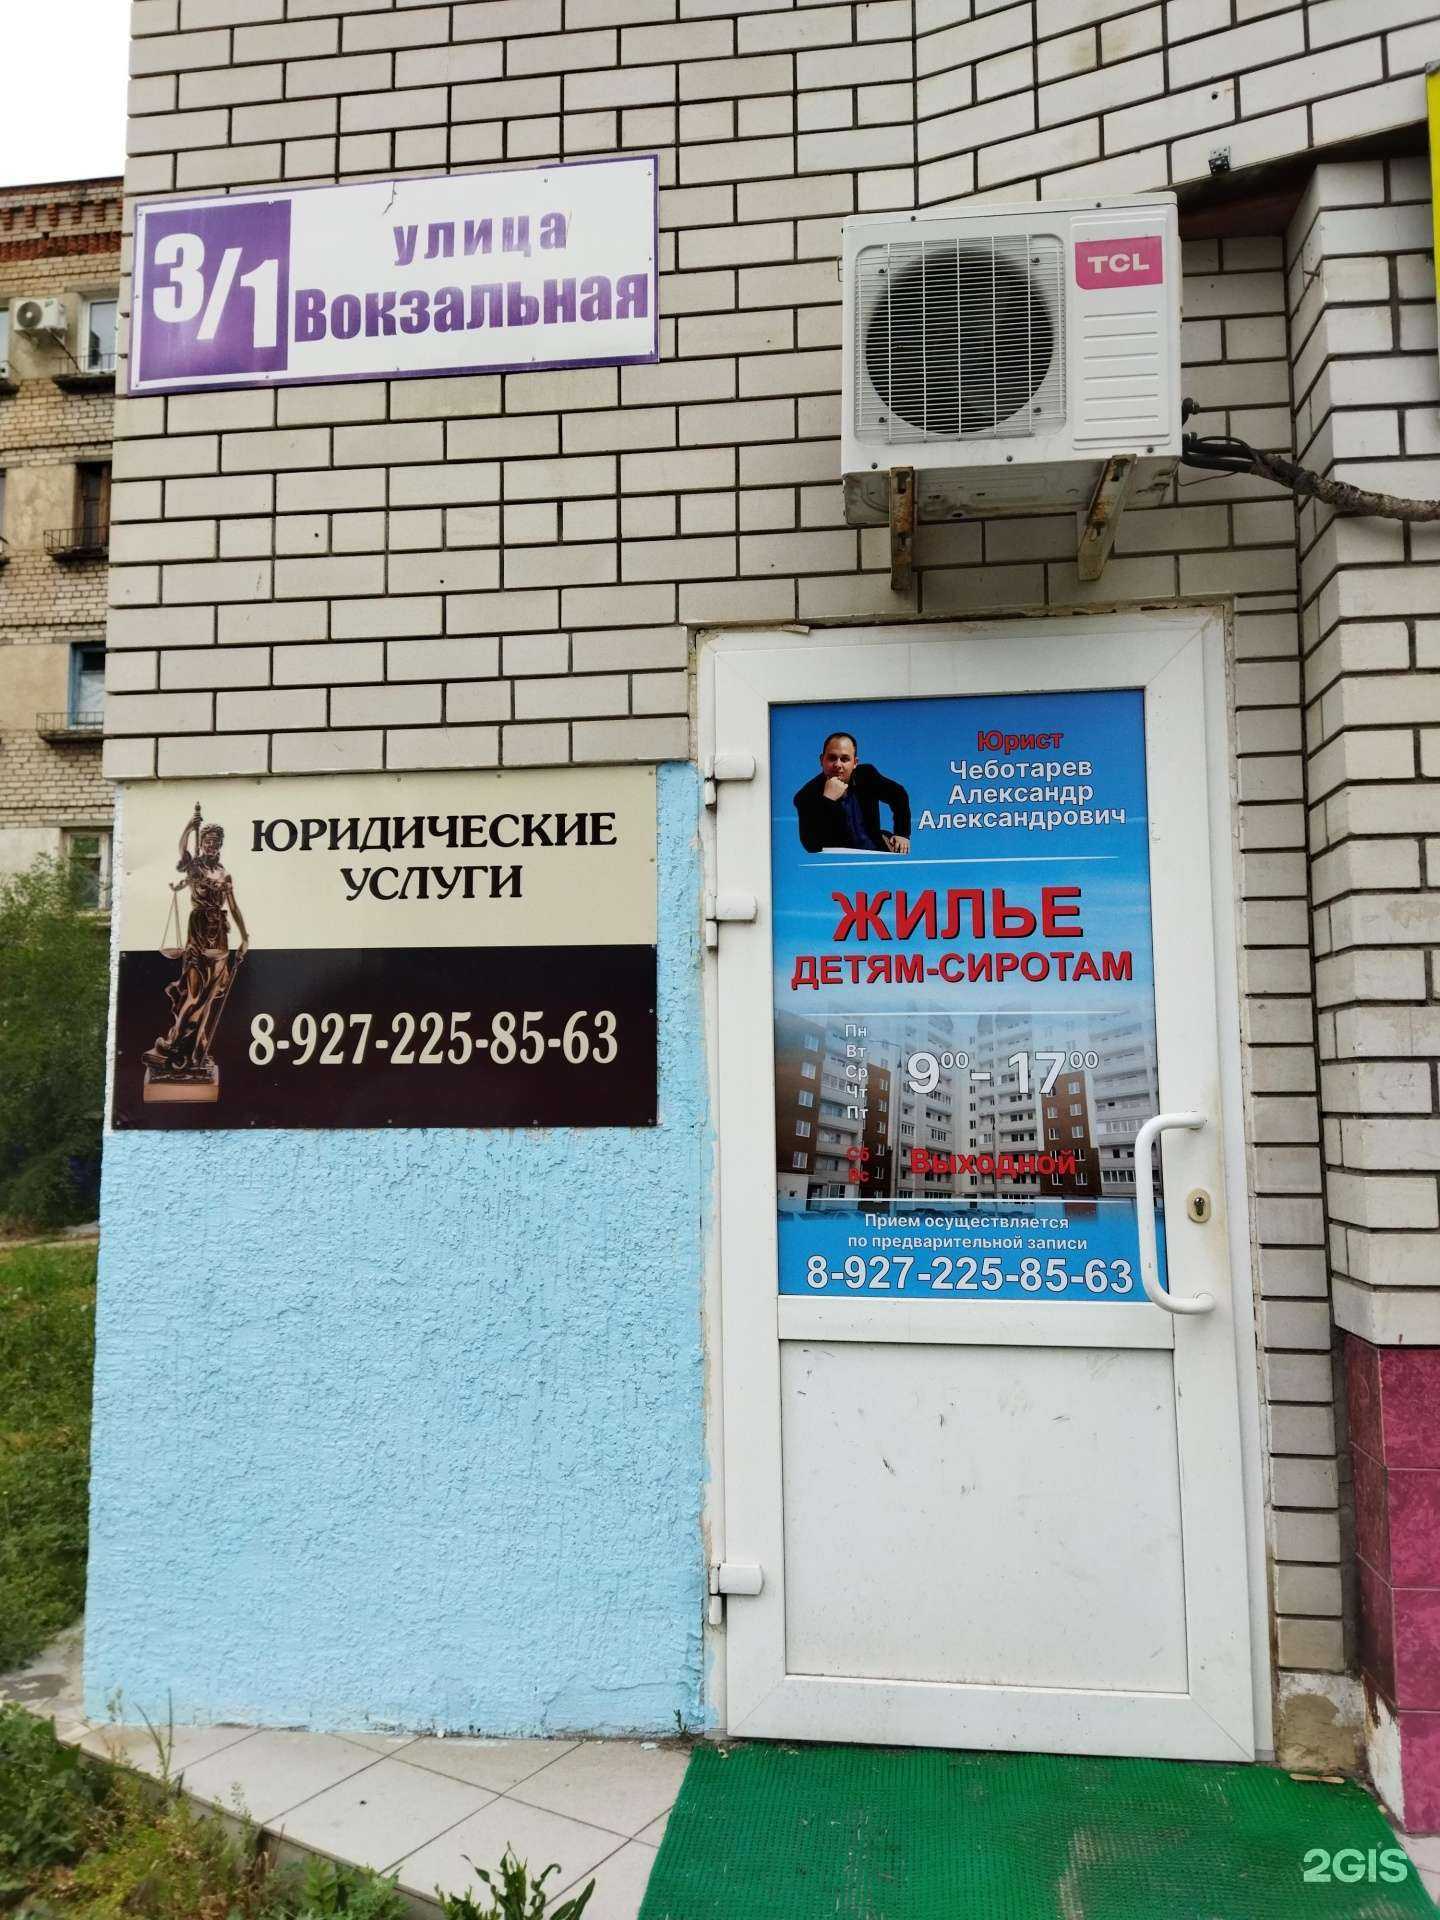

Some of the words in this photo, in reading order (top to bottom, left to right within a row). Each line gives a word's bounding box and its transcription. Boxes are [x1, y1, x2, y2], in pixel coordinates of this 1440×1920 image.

[393, 212, 568, 266] улица
[1087, 252, 1150, 274] TCL
[153, 233, 280, 348] 3/1
[977, 731, 1064, 755] Юрист
[950, 761, 1093, 781] Чеботарев
[948, 783, 1095, 805] Александр
[918, 808, 1126, 831] Александрович
[251, 812, 617, 853] ЮРИДИЧЕСКИЕ
[340, 865, 523, 901] УСЛУГИ
[832, 887, 1083, 941] ЖИЛЬЕ
[791, 951, 1133, 990] ДЕТЯМ-СИРОТАМ
[249, 1011, 618, 1065] 8-927-225-85-63
[845, 1024, 867, 1037] Пн
[846, 1044, 866, 1058] Вт
[846, 1065, 868, 1080] Ср
[846, 1085, 867, 1098] Чт
[847, 1106, 868, 1119] Пт
[847, 1147, 870, 1161] Сб
[910, 1148, 1078, 1178] Выходной
[848, 1168, 869, 1182] Вс
[864, 1214, 921, 1230] Прием
[924, 1215, 1069, 1231] осуществляется
[848, 1236, 868, 1249] по
[872, 1236, 1023, 1251] предварительной
[1027, 1238, 1087, 1251] записи
[807, 1255, 1134, 1293] 8-927-225-85-63
